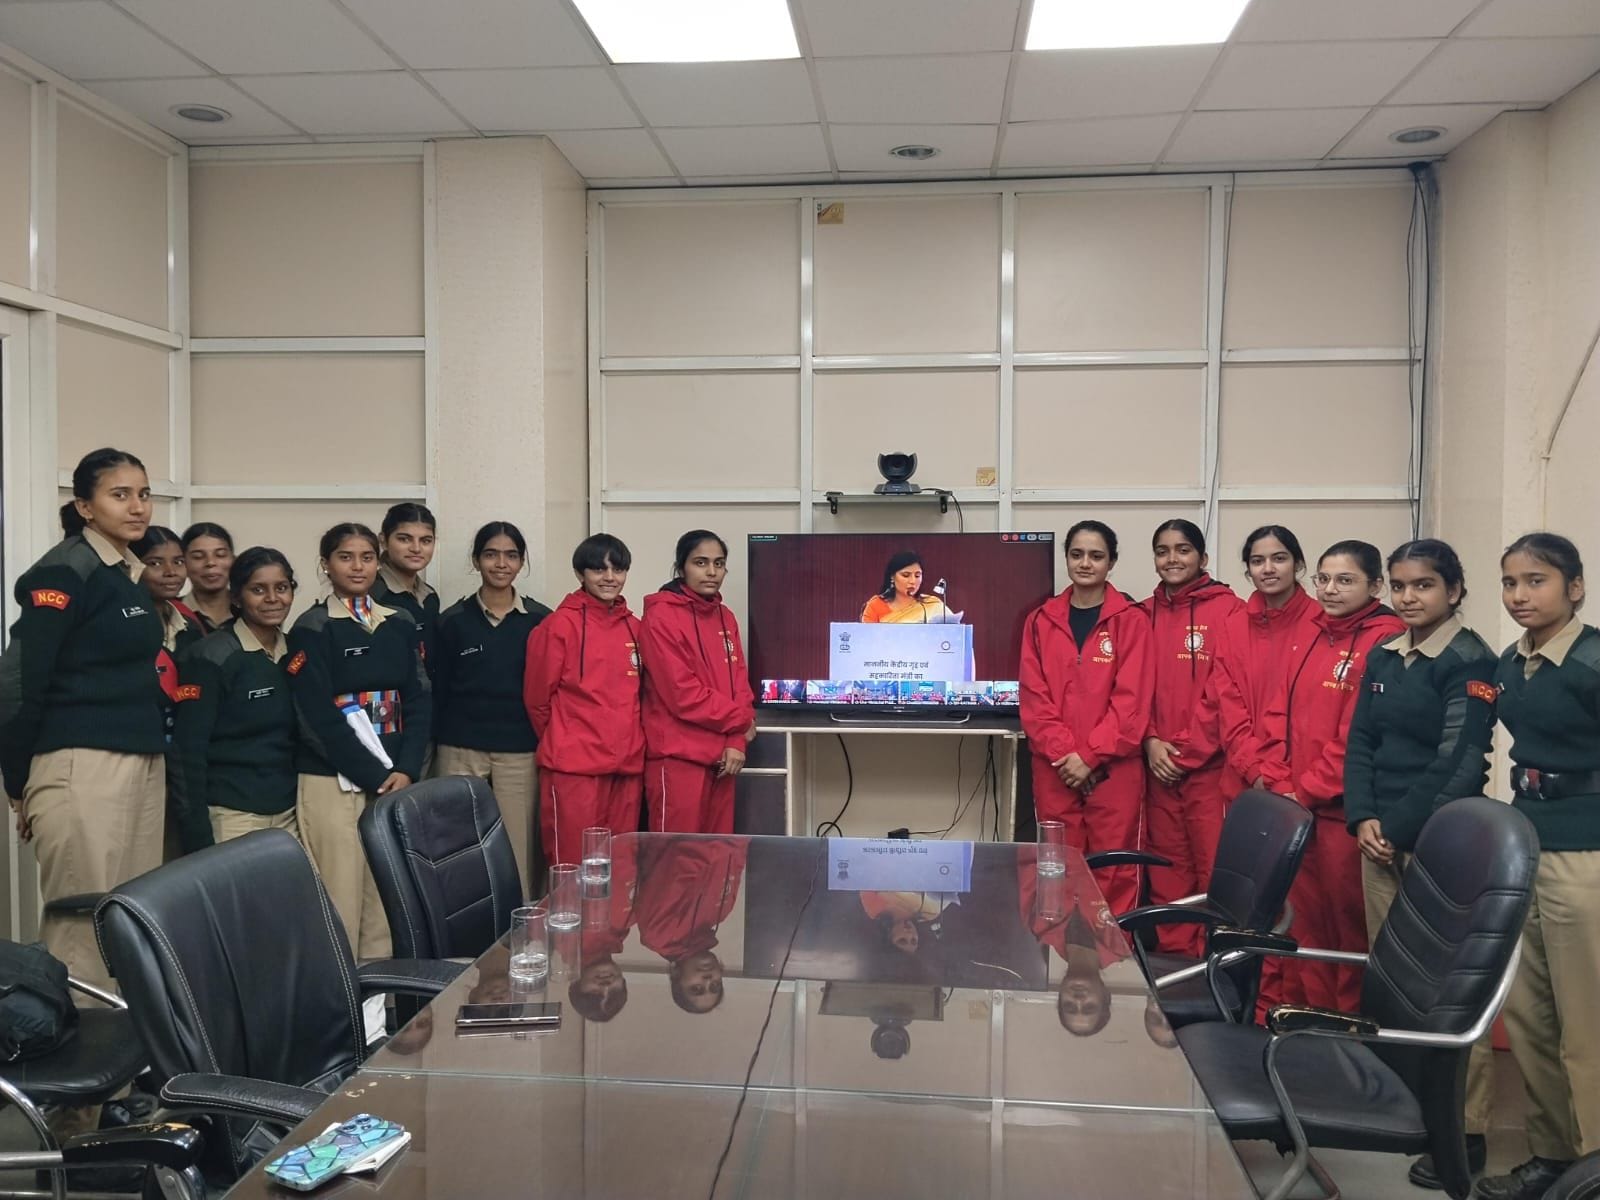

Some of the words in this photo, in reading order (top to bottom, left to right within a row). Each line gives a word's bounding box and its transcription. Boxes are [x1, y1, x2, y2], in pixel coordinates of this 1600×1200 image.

[38, 591, 65, 604] NCC
[176, 687, 197, 698] NCC
[1471, 684, 1493, 698] NCC
